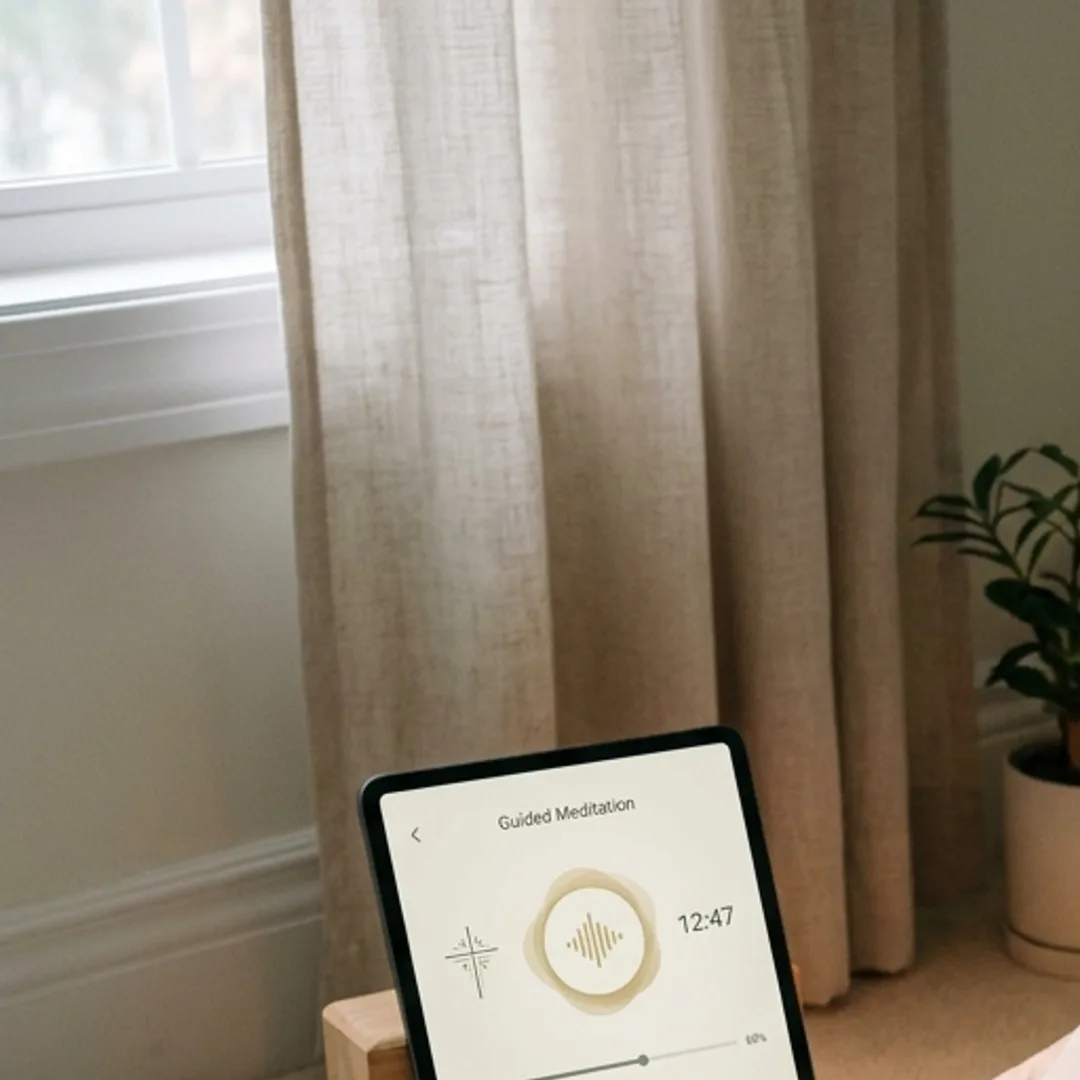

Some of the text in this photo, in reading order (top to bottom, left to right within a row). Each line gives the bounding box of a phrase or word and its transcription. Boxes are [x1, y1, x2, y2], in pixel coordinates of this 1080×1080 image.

[497, 797, 636, 831] Guided Meditation
[677, 904, 734, 934] 12:47
